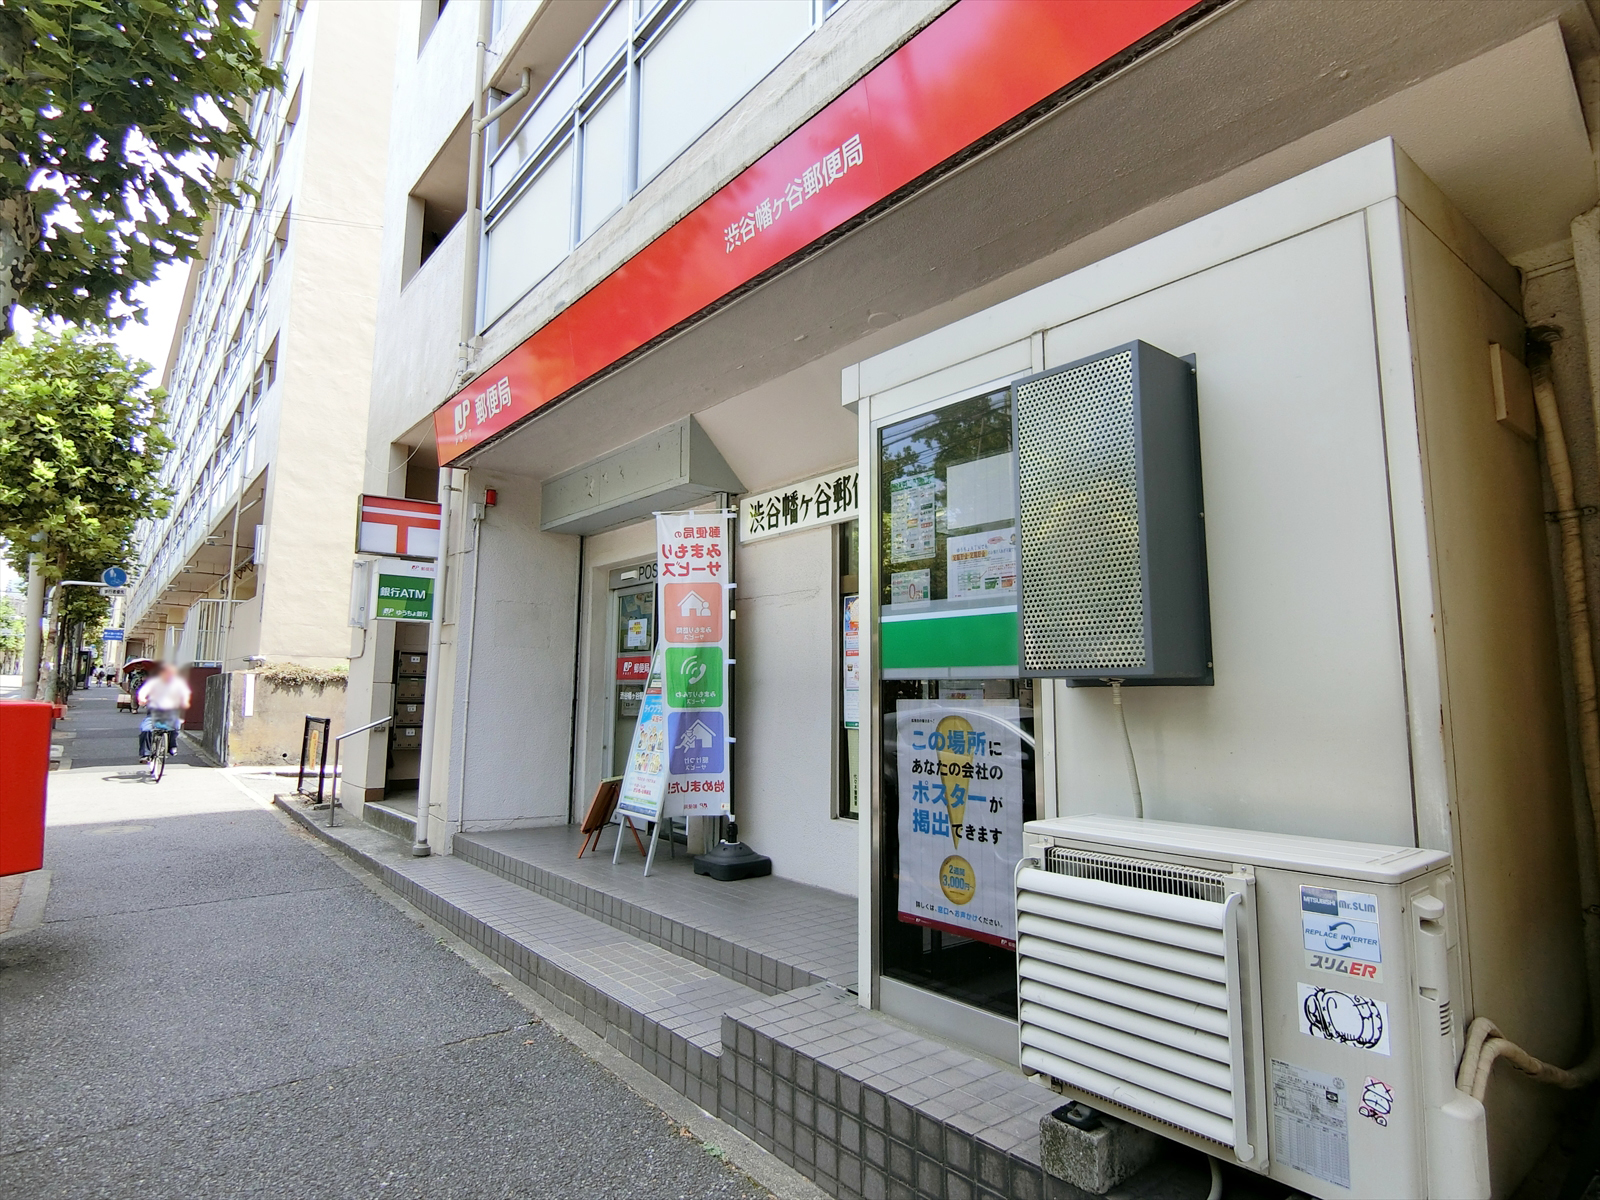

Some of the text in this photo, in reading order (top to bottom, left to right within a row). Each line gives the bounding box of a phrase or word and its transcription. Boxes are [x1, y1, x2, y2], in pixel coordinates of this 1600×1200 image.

[724, 134, 864, 254] 渋谷幡ヶ谷郵便局
[474, 376, 512, 425] 郵便局
[380, 586, 426, 599] 銀行ATM
[912, 730, 1002, 756] この場所に
[911, 758, 1003, 780] あなたの会社の
[912, 780, 1003, 813] ポスターが
[912, 808, 1003, 844] 掲出できます
[1339, 899, 1376, 913] Mr.SLIM
[1305, 928, 1378, 946] REPLACE INVERTER
[1310, 954, 1377, 979] スリムER
